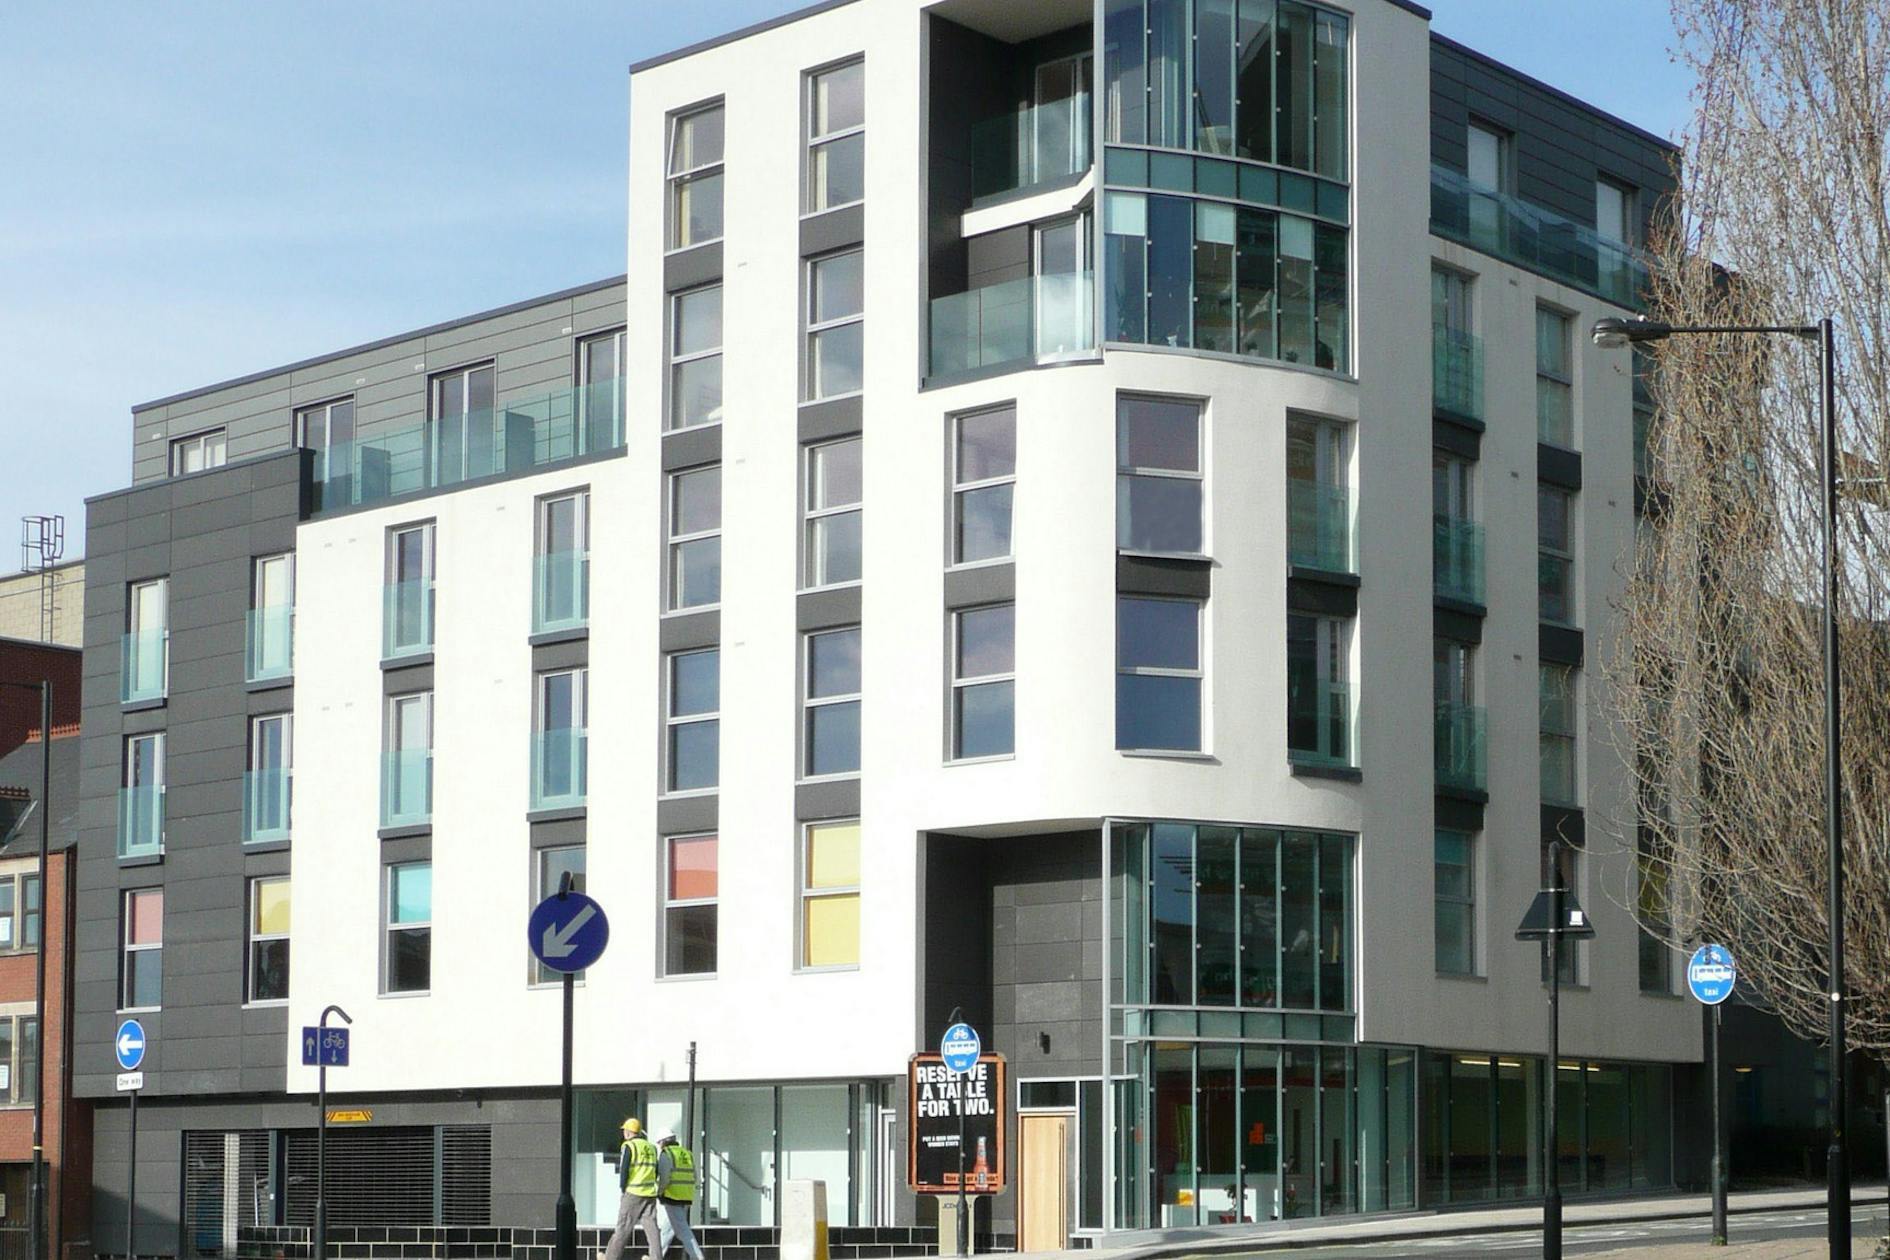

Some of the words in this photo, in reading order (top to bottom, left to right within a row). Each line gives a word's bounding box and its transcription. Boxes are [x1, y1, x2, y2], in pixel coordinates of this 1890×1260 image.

[917, 1064, 987, 1084] RESEVE
[922, 1083, 934, 1100] A
[918, 1100, 950, 1118] FOR
[953, 1098, 995, 1116] TWO.
